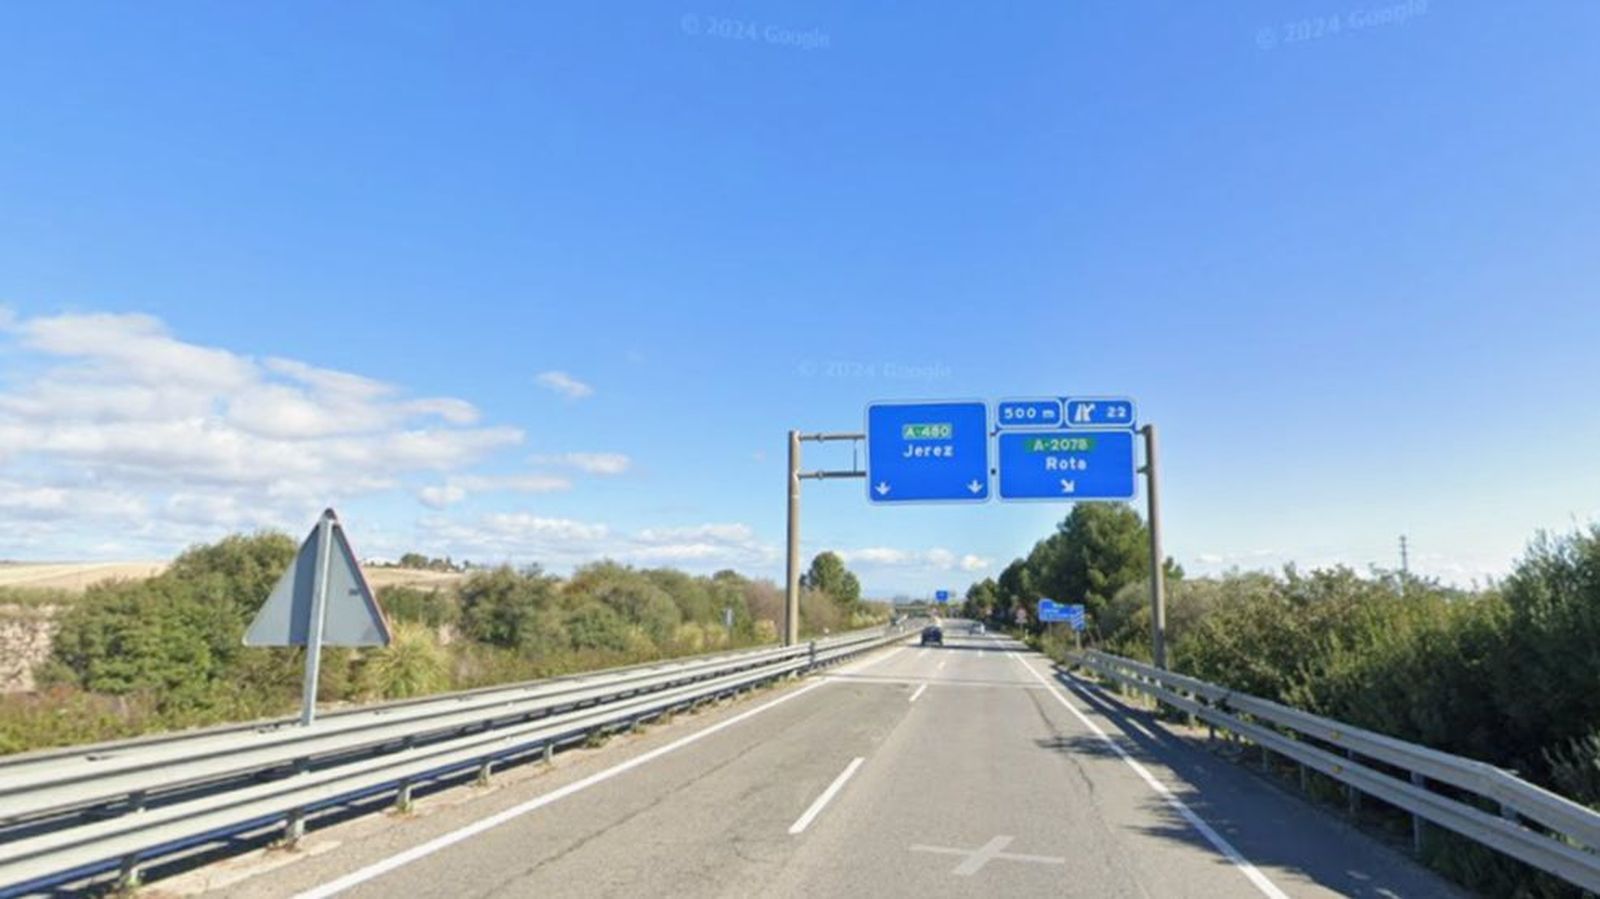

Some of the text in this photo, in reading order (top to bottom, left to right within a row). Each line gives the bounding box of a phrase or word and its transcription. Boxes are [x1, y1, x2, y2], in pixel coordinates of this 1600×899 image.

[1004, 407, 1055, 419] 500 m
[1106, 406, 1126, 418] 22
[903, 444, 953, 458] Jerez
[1046, 457, 1087, 470] Rota
